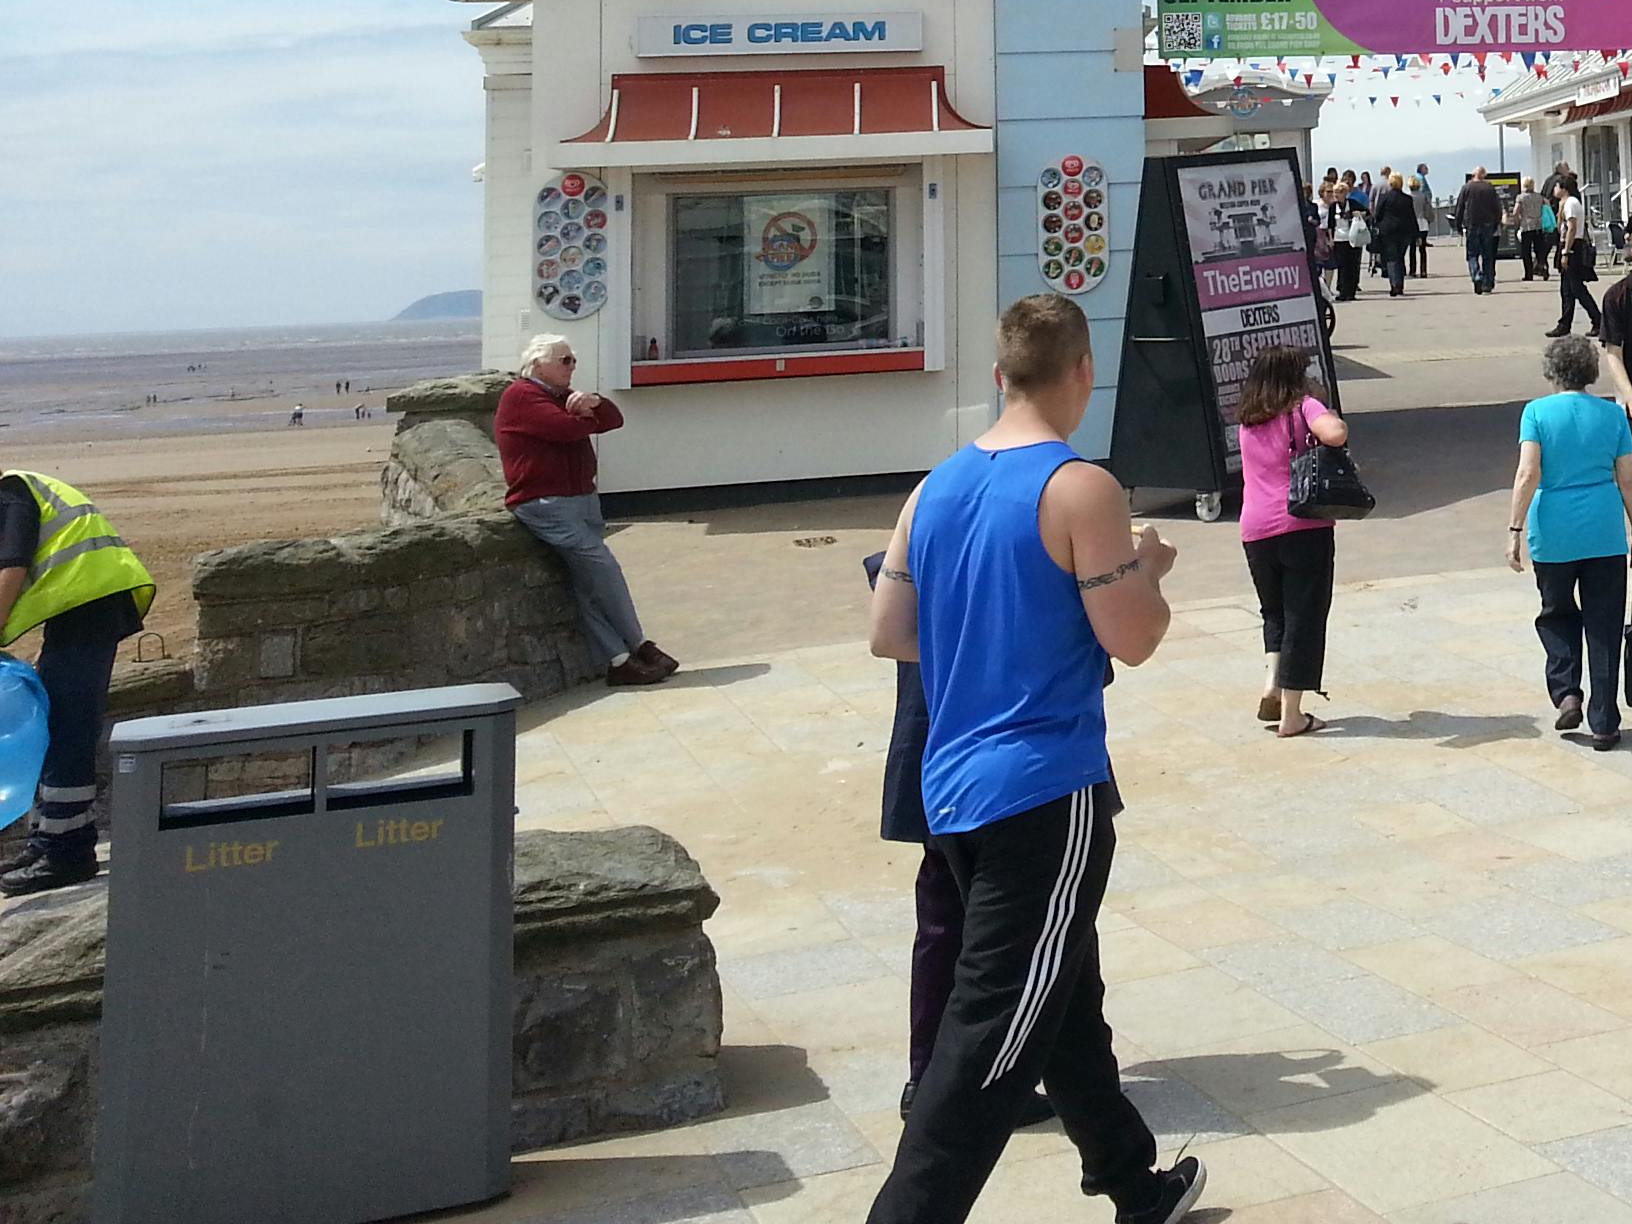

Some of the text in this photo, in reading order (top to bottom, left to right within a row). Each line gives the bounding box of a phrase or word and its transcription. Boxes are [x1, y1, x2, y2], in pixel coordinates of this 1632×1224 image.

[672, 20, 887, 45] ICE CREAM
[1435, 4, 1566, 45] DEXTERS
[1199, 178, 1277, 200] GRAND PIER
[1203, 265, 1300, 296] TheEnemy
[1240, 304, 1280, 328] DEXTERS
[1213, 324, 1317, 364] 28TH SEPTEMBER
[1213, 360, 1249, 383] DOORS
[355, 818, 444, 848] Litter
[185, 839, 279, 872] Litter
